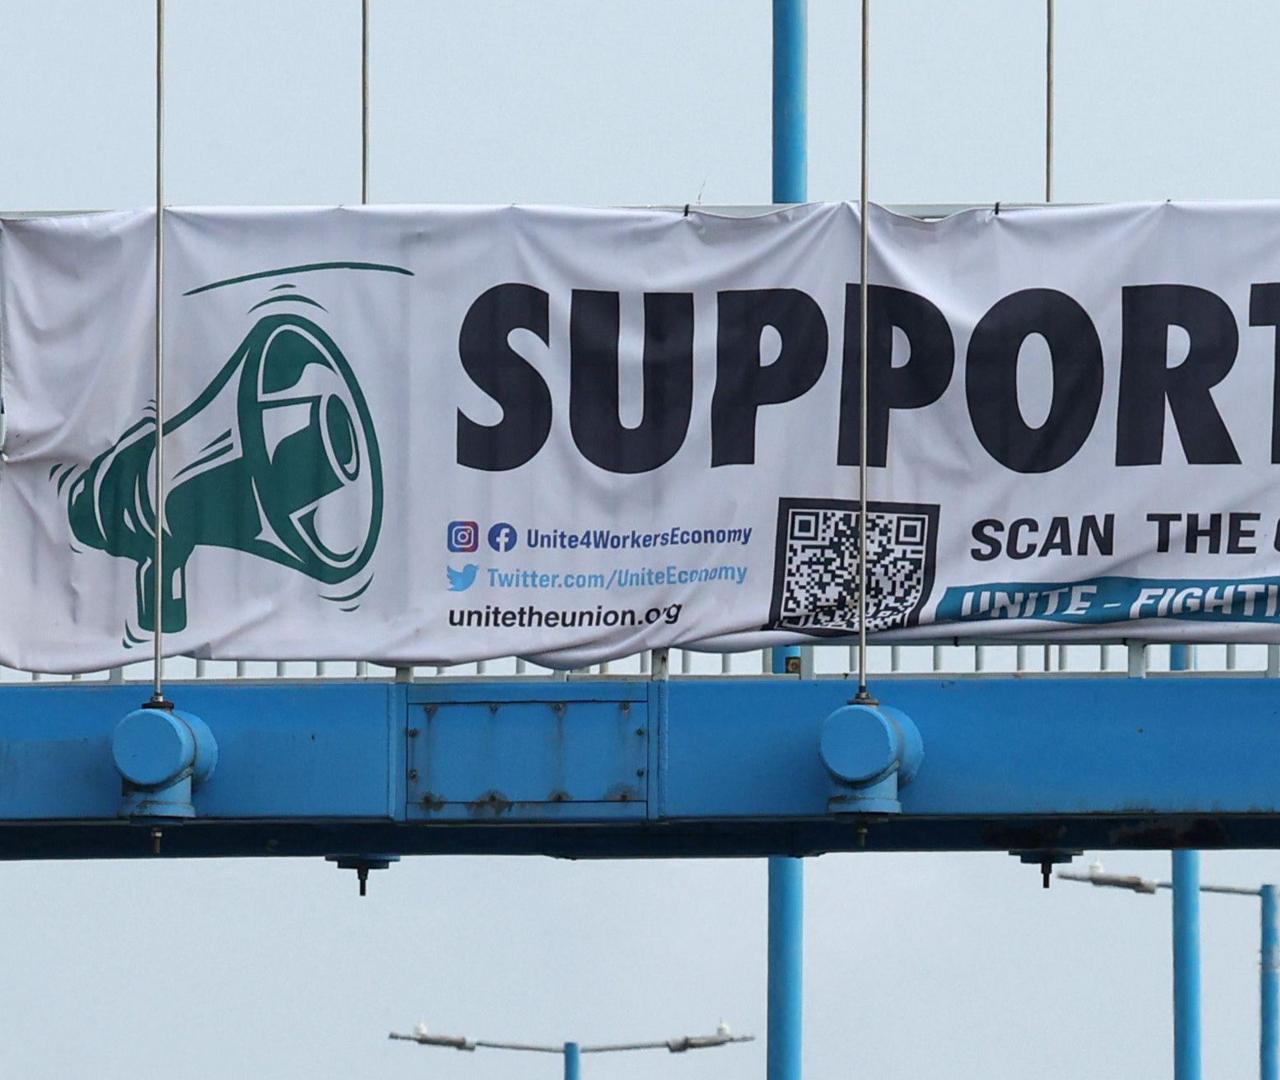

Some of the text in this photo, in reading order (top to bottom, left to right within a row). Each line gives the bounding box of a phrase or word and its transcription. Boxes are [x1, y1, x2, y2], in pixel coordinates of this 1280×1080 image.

[526, 527, 753, 550] Unite4WorkersEconomy
[970, 513, 1116, 561] SCAN
[1147, 512, 1261, 556] THE
[487, 565, 748, 591] Twitter.com/UniteEconomy
[961, 585, 1098, 618] UNITE
